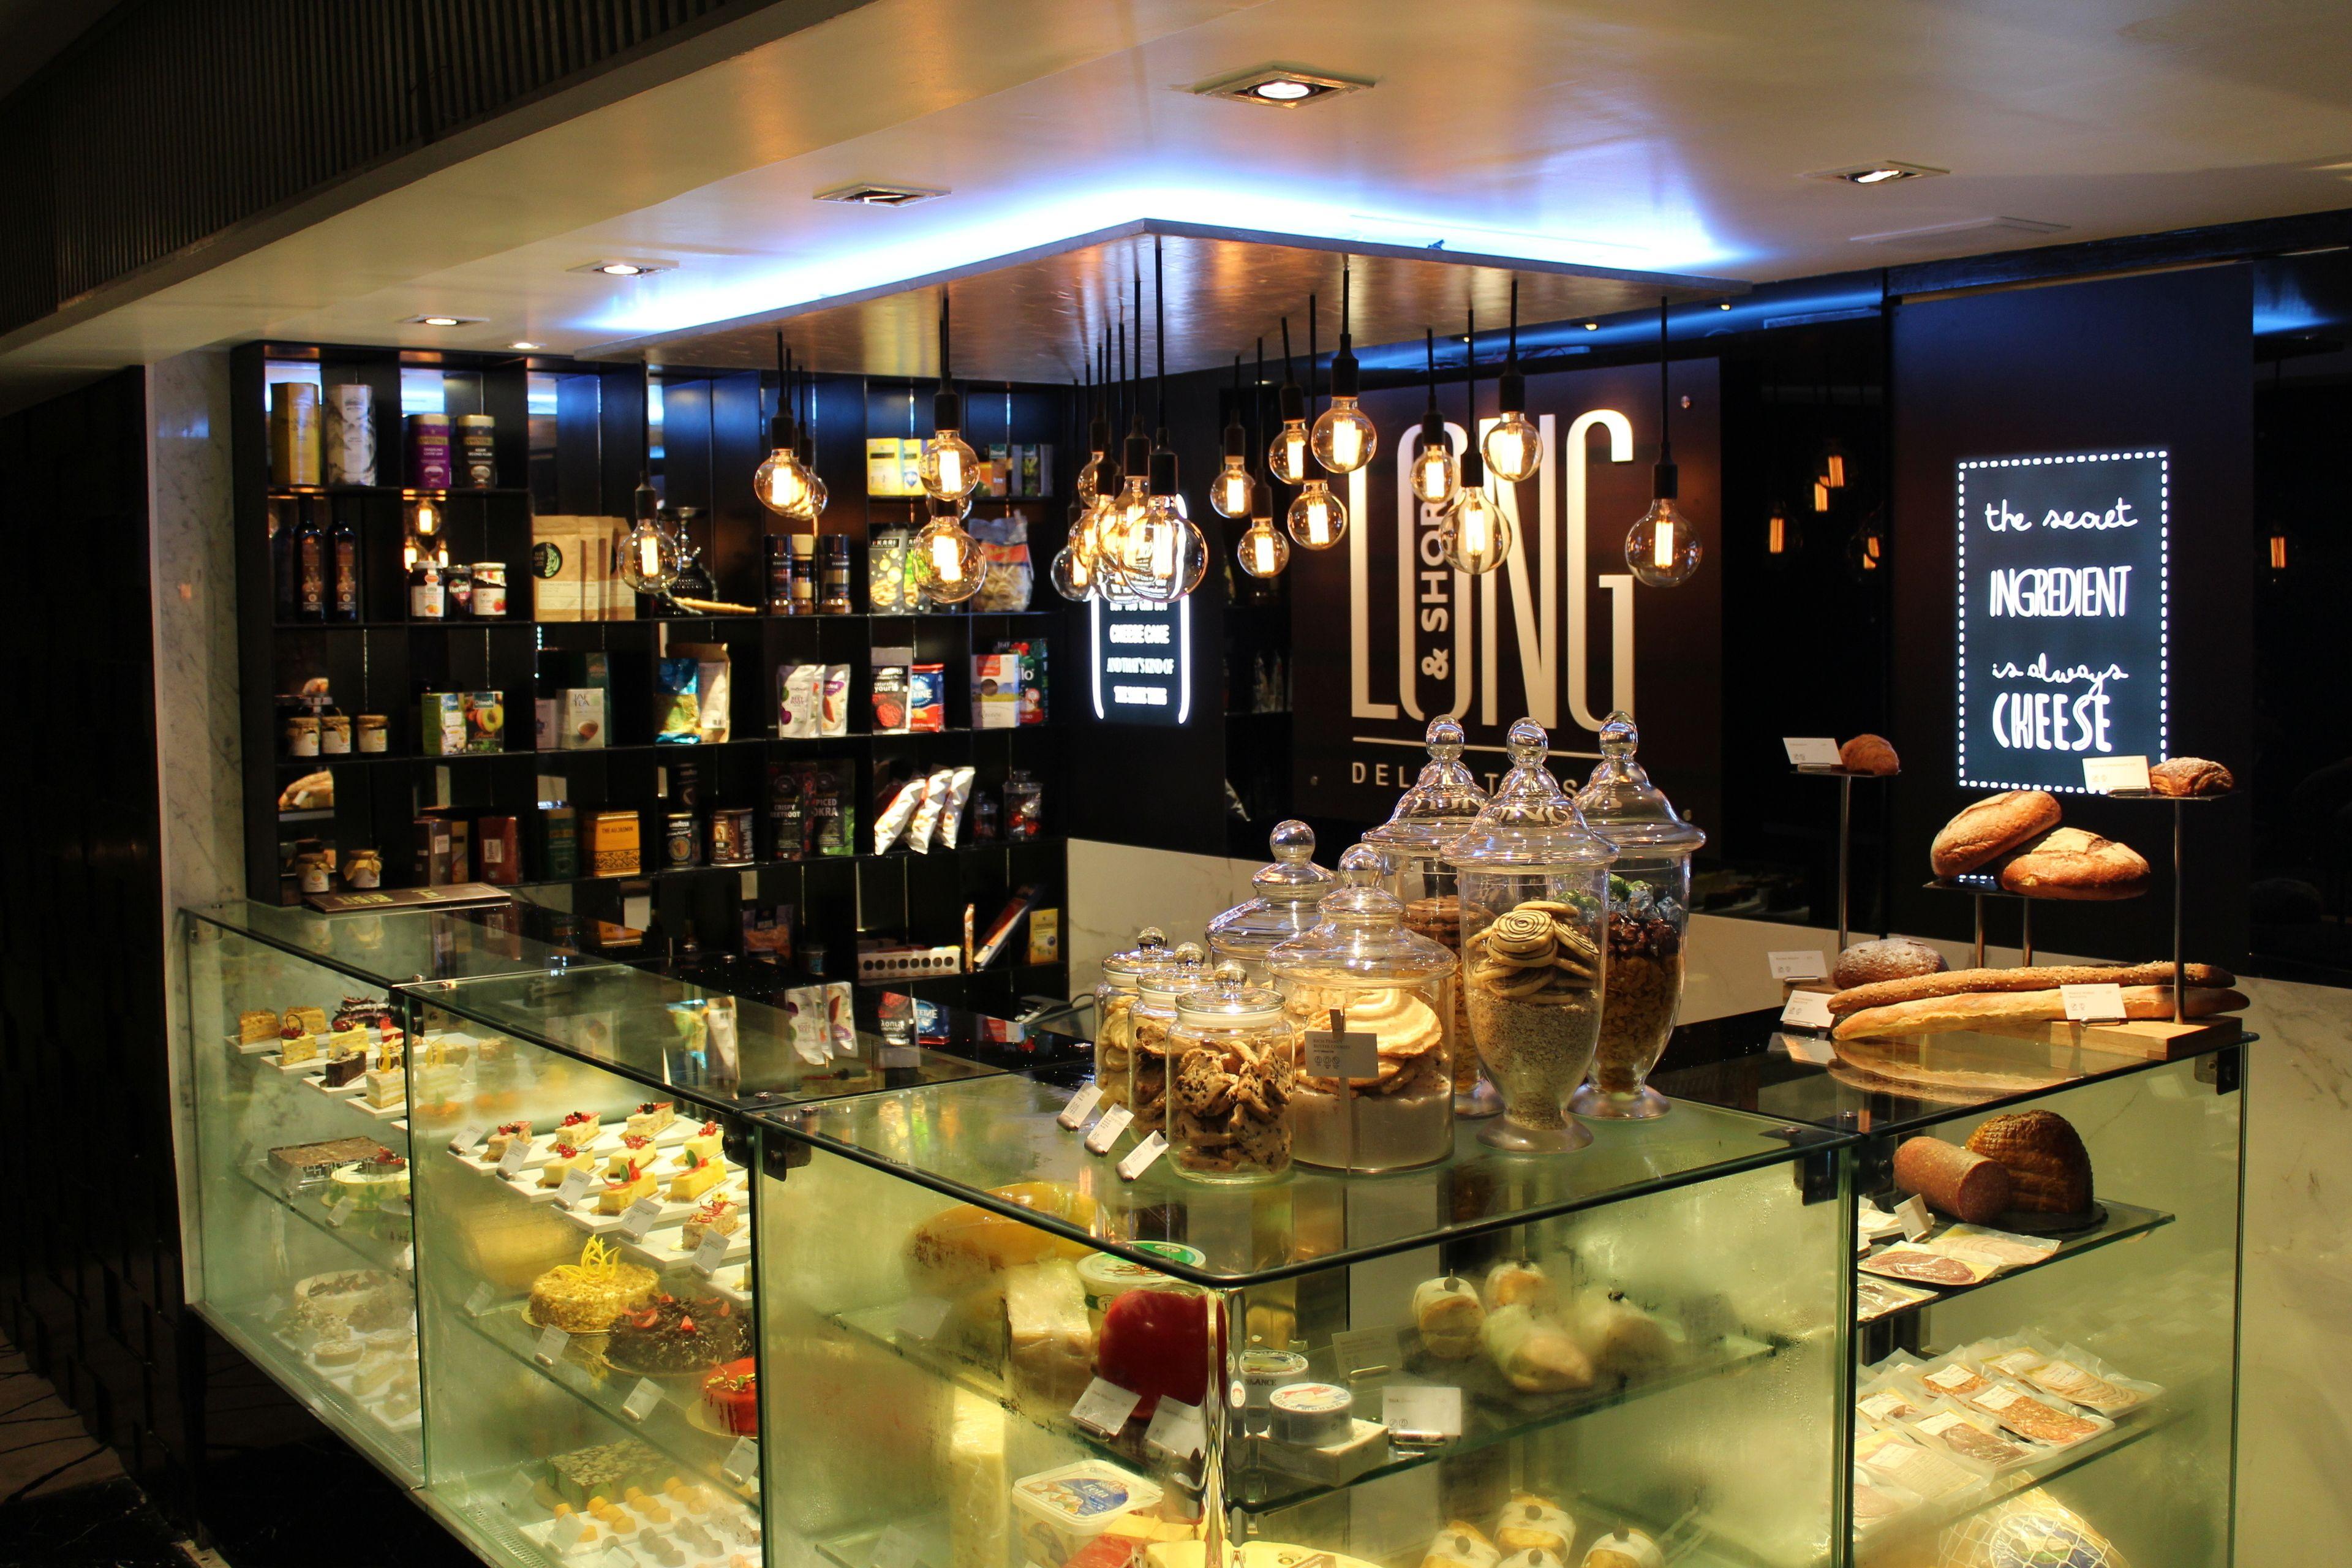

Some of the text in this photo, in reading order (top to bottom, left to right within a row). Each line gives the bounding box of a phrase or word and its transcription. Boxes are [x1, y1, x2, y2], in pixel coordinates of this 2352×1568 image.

[1985, 497, 2138, 532] the secret
[1349, 409, 1635, 731] LONG
[1420, 499, 1449, 632] SHOR
[1989, 565, 2132, 617] INGREDIENT
[1992, 652, 2128, 696] is always
[1992, 693, 2112, 752] CHEESE
[812, 807, 839, 817] OKRA
